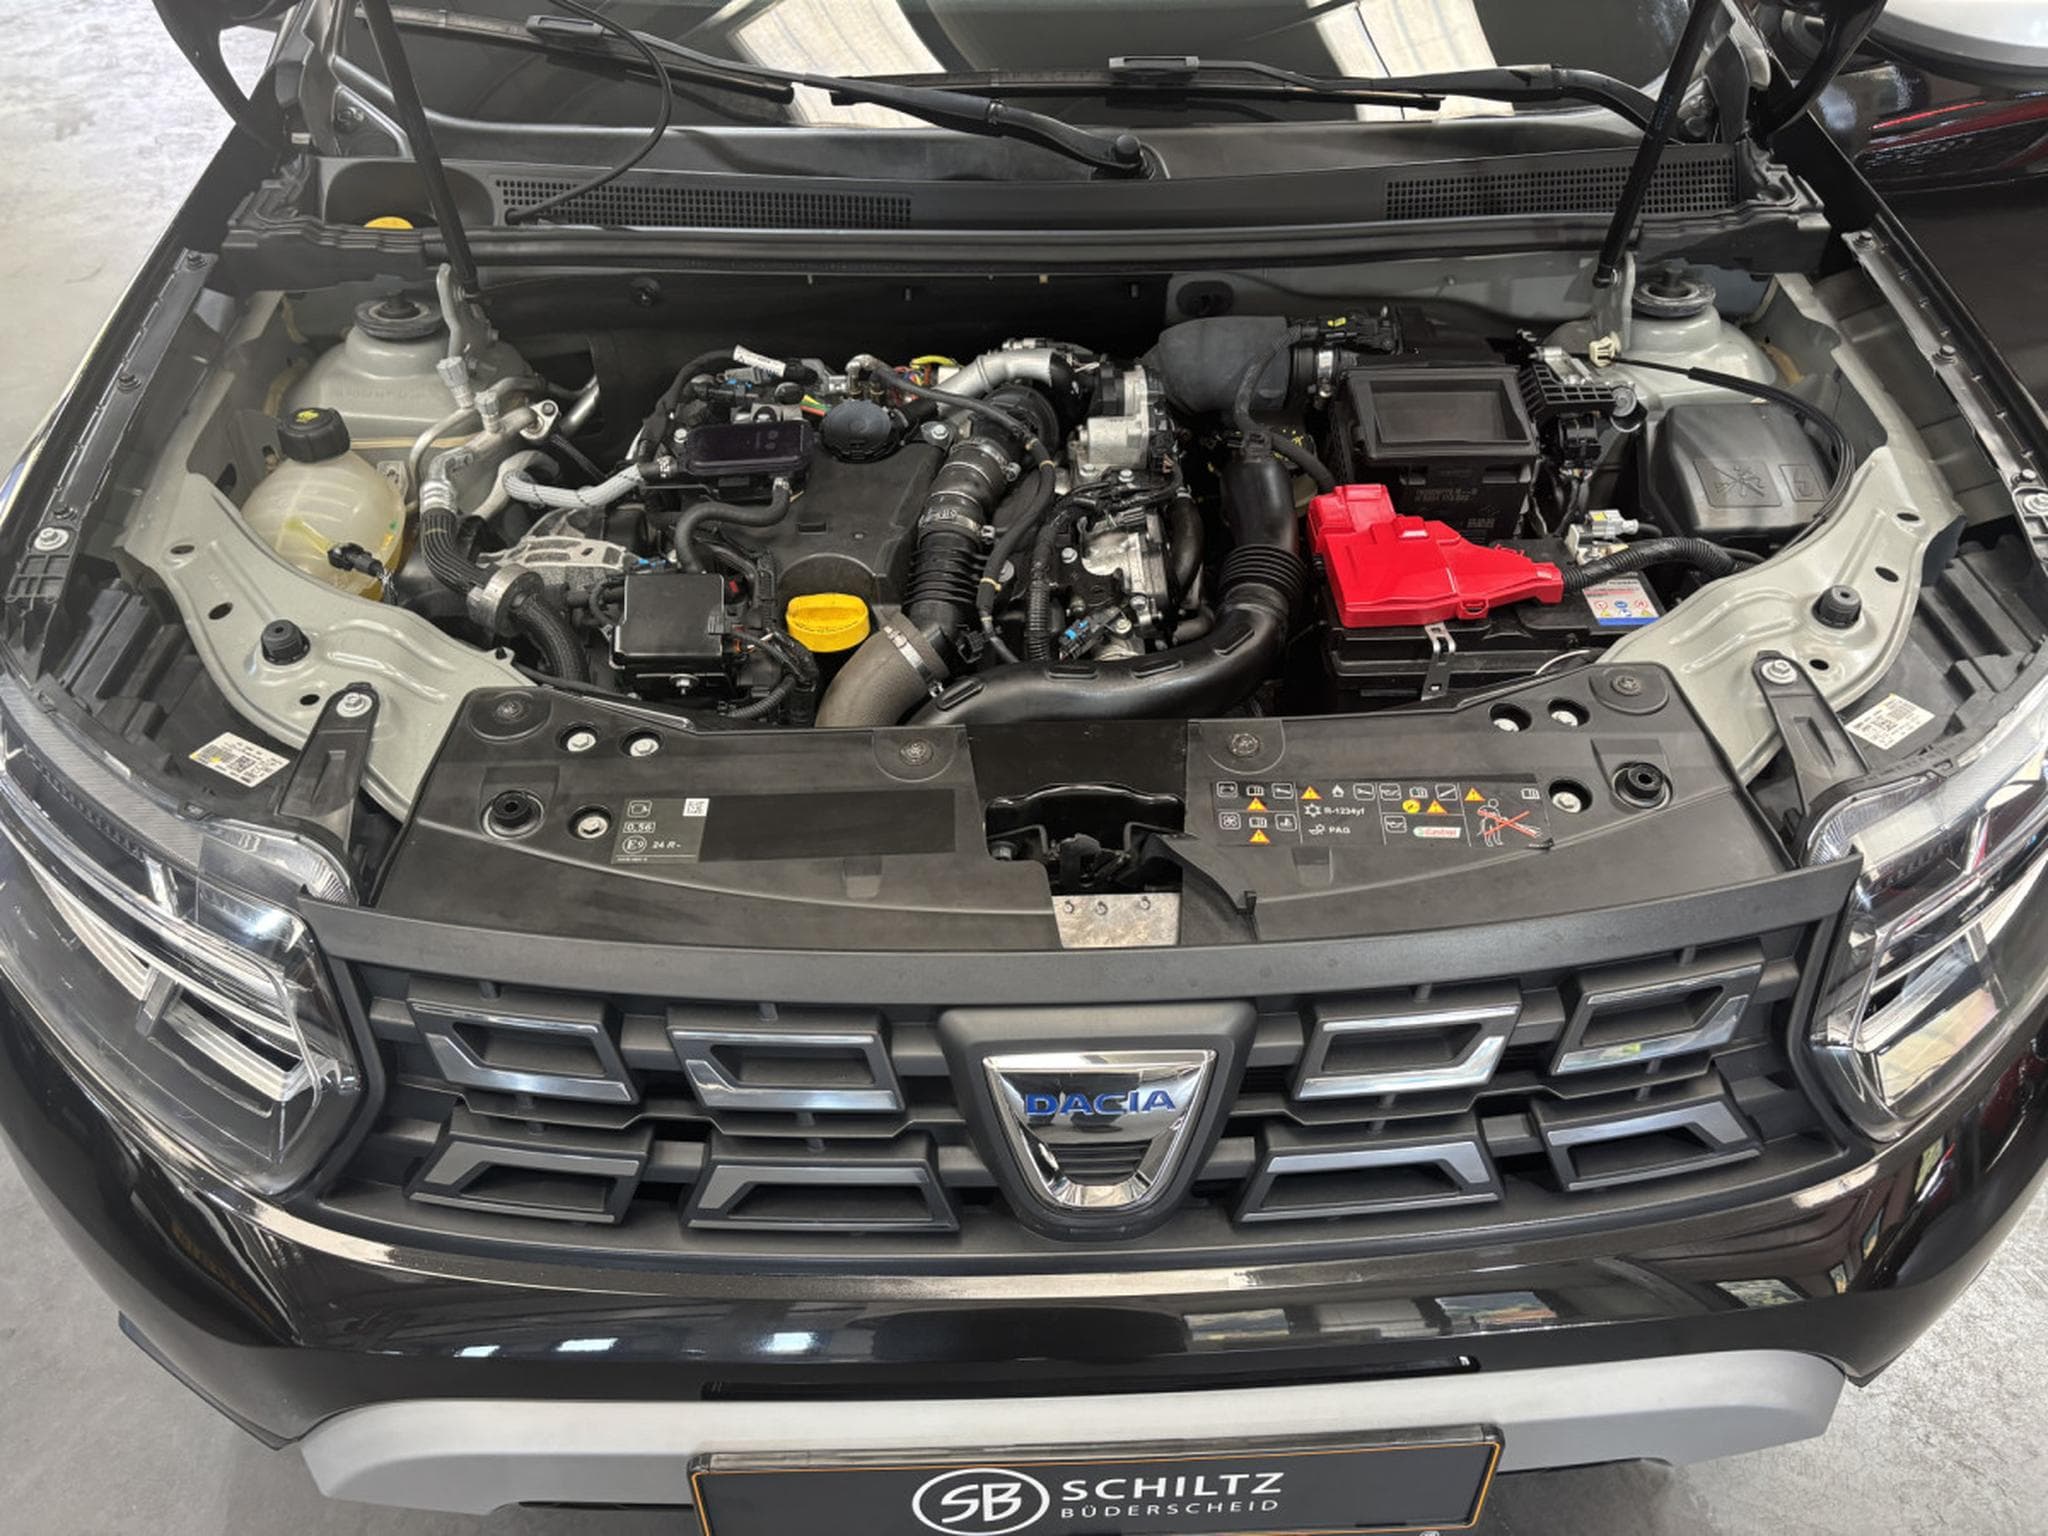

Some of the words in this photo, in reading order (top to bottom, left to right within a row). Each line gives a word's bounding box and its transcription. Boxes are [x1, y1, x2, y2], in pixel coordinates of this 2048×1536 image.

[1025, 1090, 1177, 1116] DACIA
[941, 1483, 1022, 1524] SB
[1062, 1472, 1285, 1501] SCHILTZ
[1061, 1499, 1279, 1519] BÜDERSCHEID
